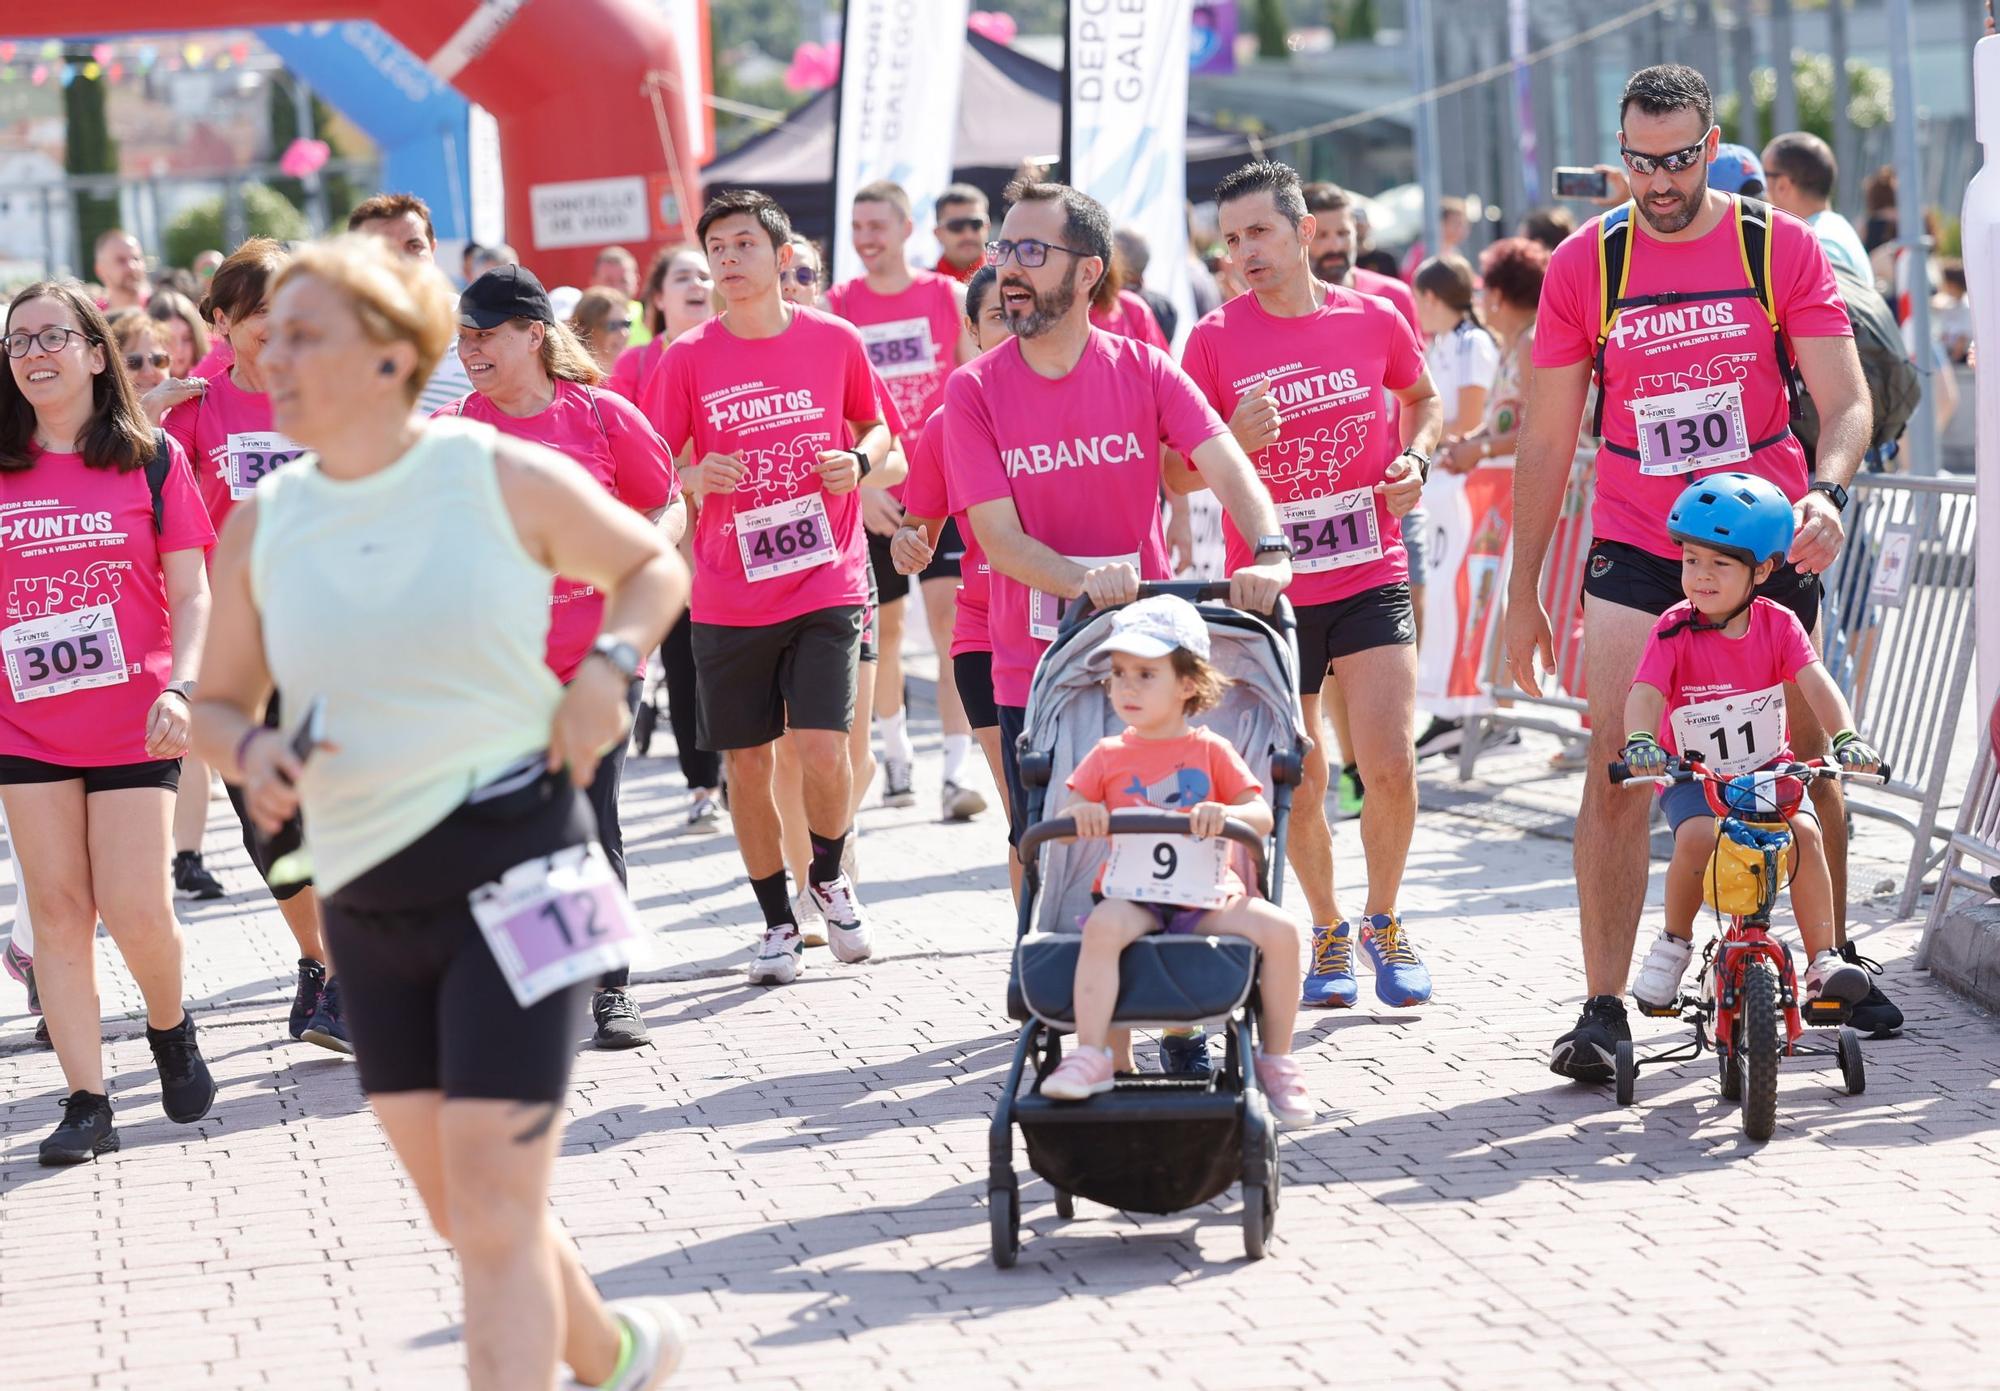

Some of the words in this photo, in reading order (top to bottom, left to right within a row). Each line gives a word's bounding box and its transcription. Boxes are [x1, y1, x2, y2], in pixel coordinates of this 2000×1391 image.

[869, 336, 919, 366] 585
[1244, 368, 1358, 405] XUNTOS
[1654, 413, 1728, 457] 130
[754, 519, 818, 559] 468
[1292, 513, 1358, 555] 541
[24, 634, 104, 681] 305
[1710, 721, 1756, 760] 11
[1152, 842, 1178, 880] 9
[538, 891, 609, 948] 12
